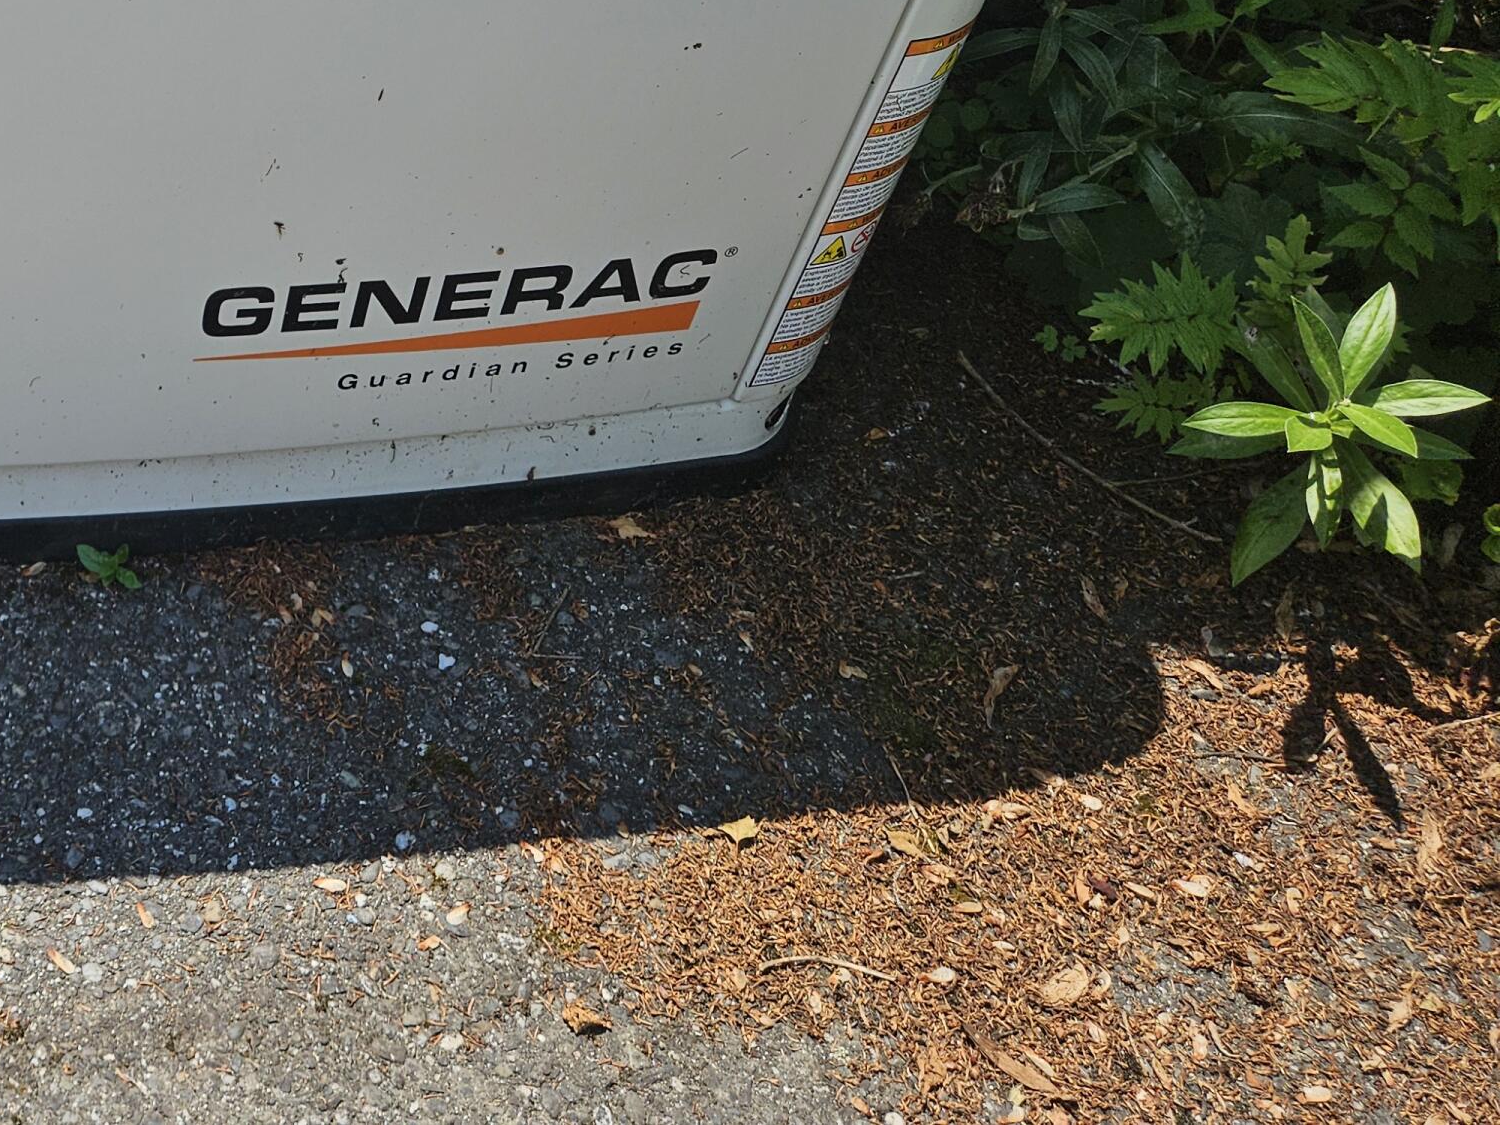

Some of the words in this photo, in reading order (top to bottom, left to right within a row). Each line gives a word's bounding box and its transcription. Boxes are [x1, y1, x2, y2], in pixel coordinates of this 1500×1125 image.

[202, 249, 718, 337] GENERAC
[337, 358, 528, 390] Guardian
[555, 339, 684, 369] Series
